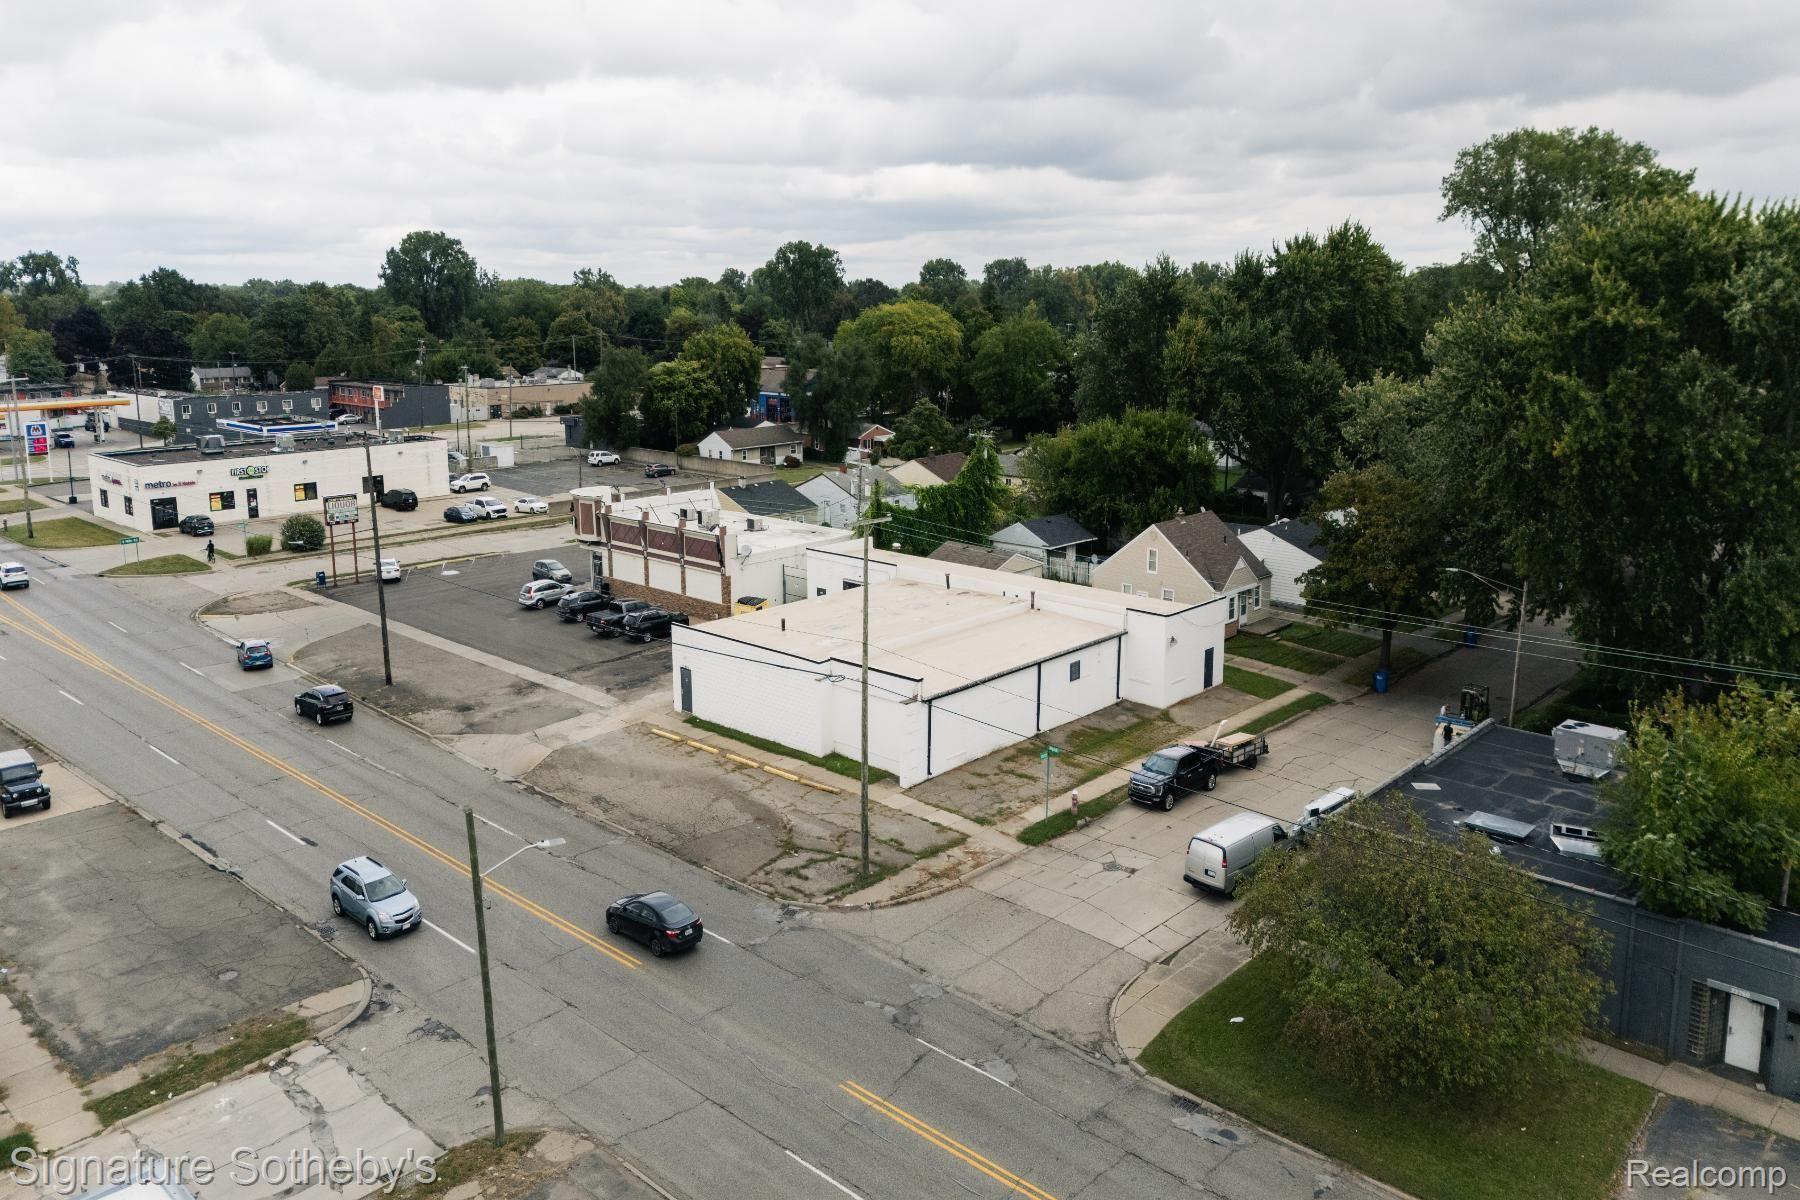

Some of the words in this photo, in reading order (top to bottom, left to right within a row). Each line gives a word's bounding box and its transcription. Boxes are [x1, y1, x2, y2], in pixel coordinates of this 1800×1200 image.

[230, 467, 247, 476] FIRST
[144, 480, 171, 489] metro
[327, 500, 356, 510] LIQUOR
